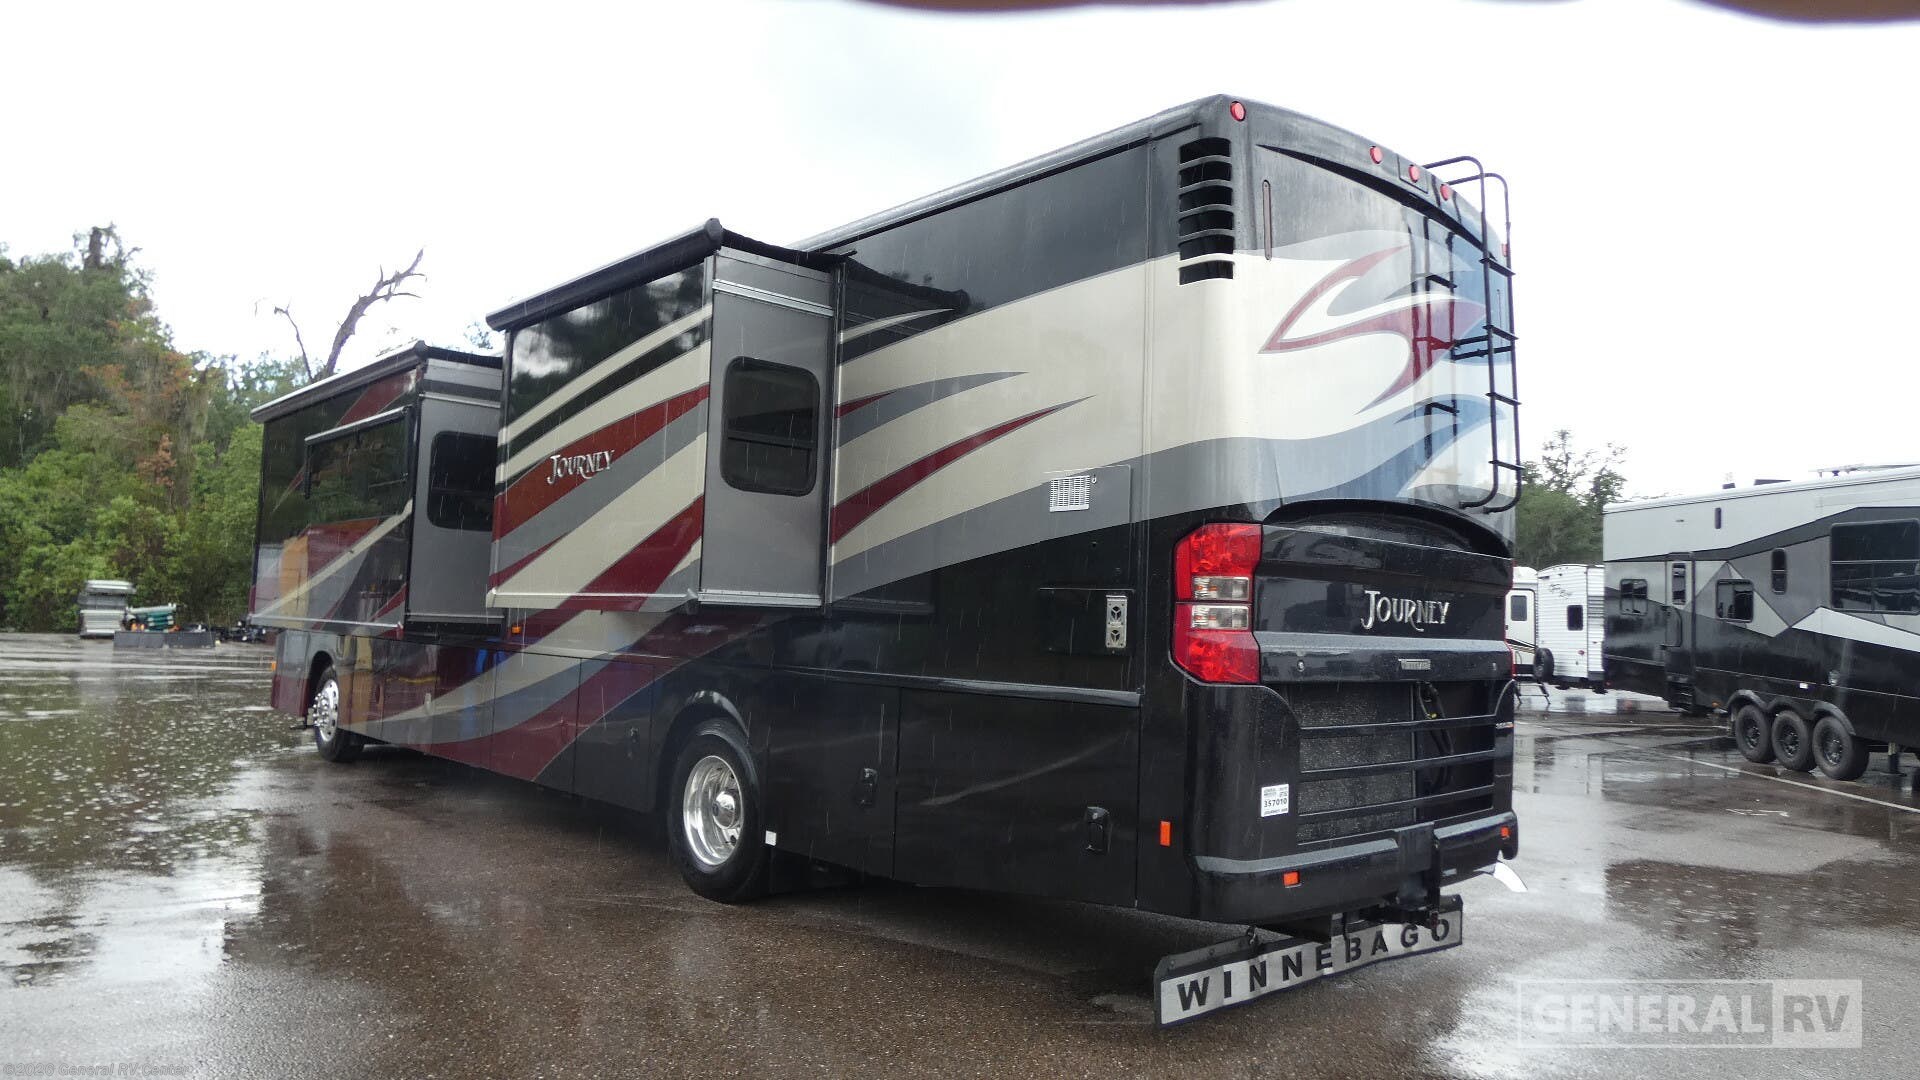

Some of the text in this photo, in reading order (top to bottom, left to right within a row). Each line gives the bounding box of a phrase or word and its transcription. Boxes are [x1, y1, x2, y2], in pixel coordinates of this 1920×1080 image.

[546, 449, 615, 484] JOURNEY
[1360, 589, 1450, 632] JOURNEY
[1177, 918, 1451, 1012] WINNEBAGO
